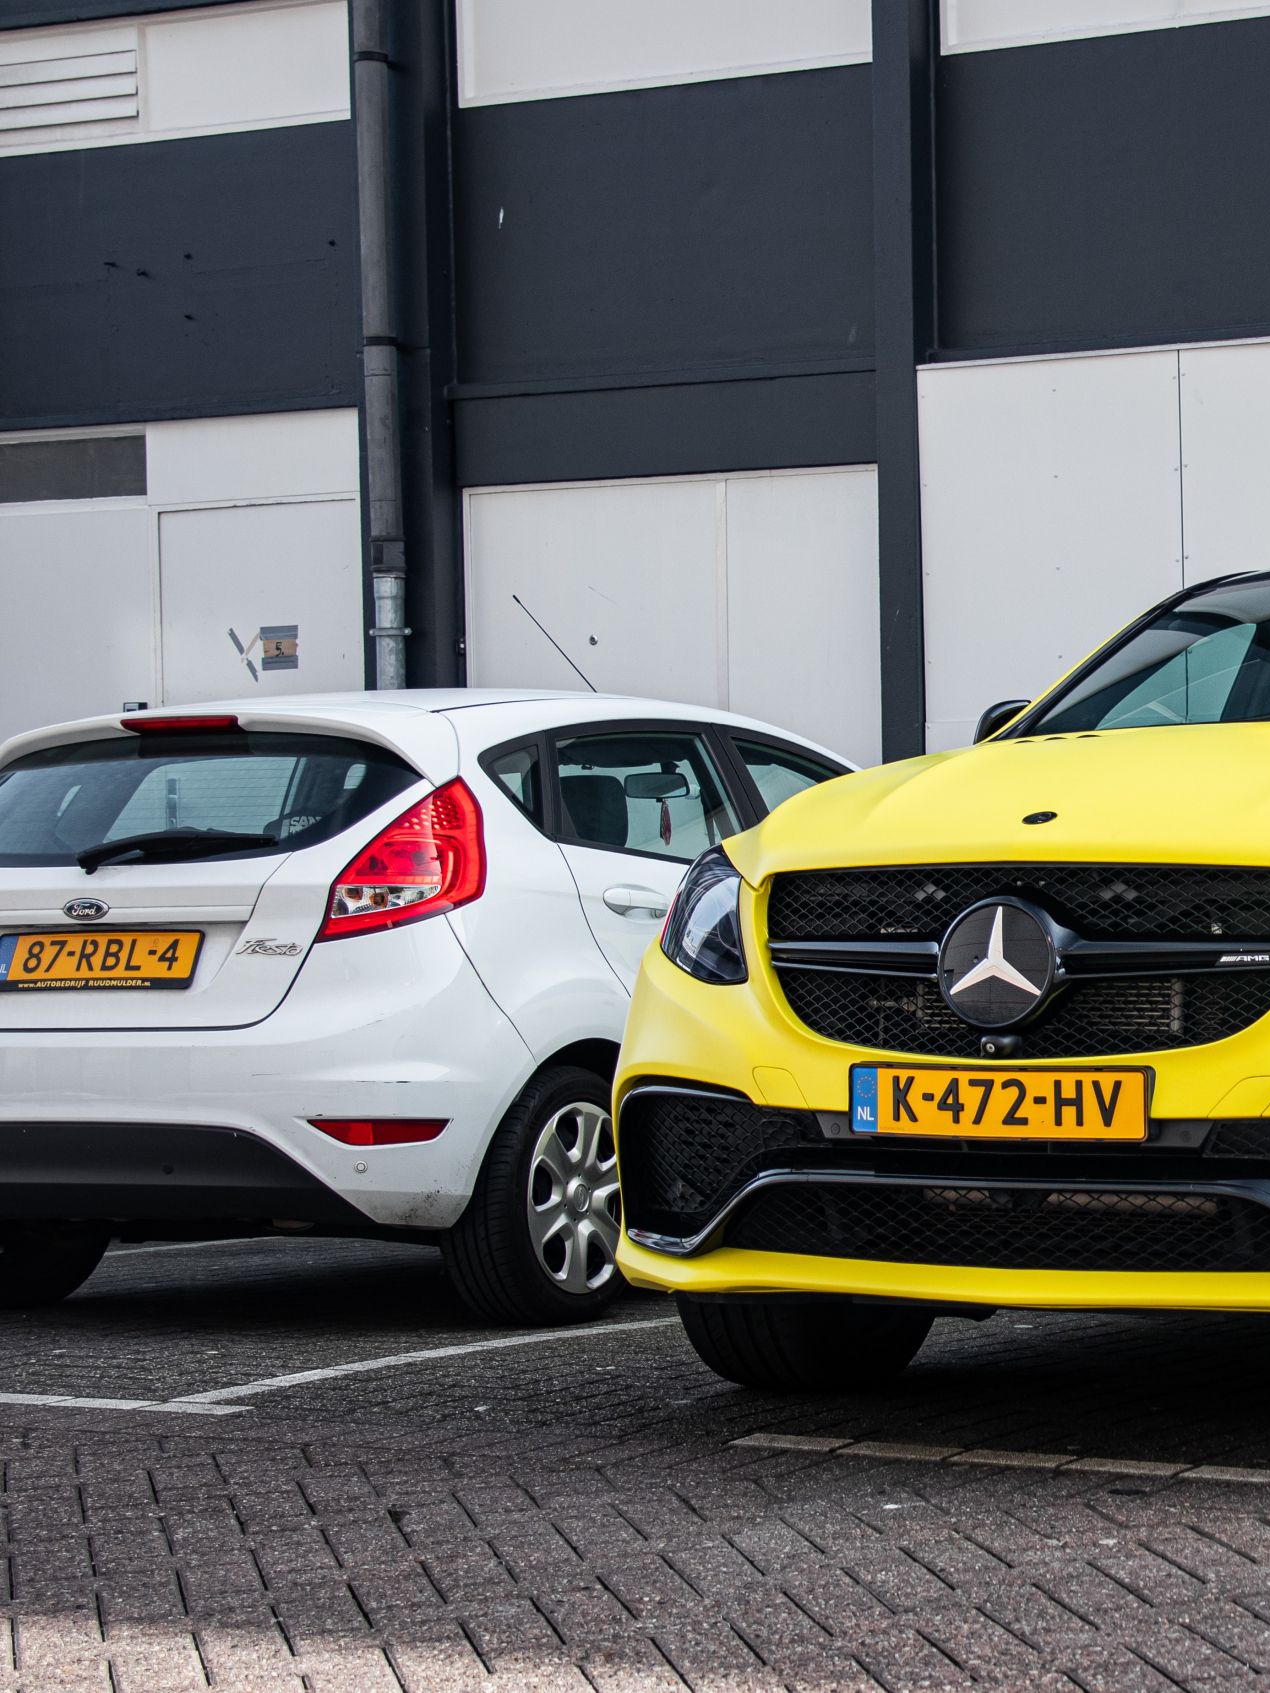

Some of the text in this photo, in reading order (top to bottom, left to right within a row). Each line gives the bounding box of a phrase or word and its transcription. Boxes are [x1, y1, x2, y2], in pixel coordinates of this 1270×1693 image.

[71, 903, 97, 916] Ford
[22, 938, 180, 973] 87-RBL-4
[235, 938, 303, 956] Fiesta
[892, 1075, 1122, 1127] K-472-HV
[857, 1106, 875, 1121] NL
